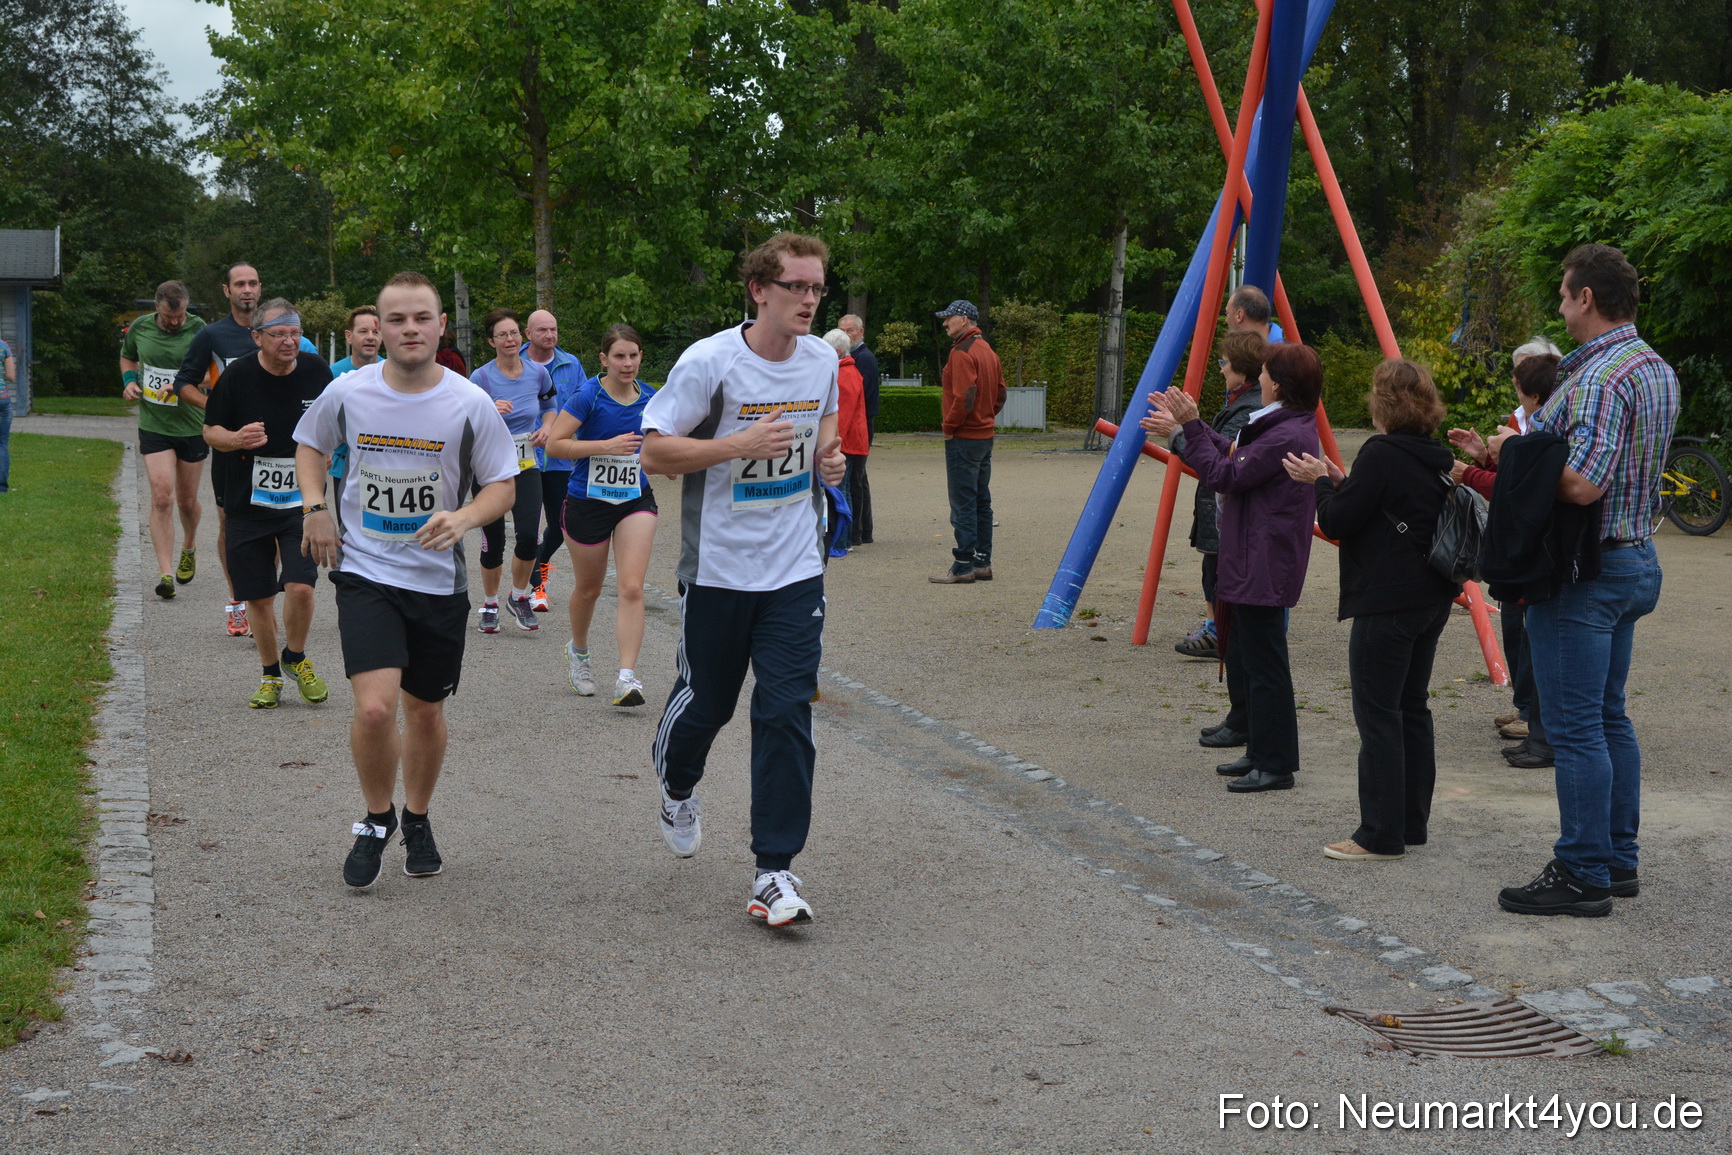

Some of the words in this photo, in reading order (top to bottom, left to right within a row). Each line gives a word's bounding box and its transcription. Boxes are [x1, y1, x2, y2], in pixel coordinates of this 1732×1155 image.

[357, 433, 445, 452] grasenhiller
[384, 448, 417, 456] KOMPETENZ
[591, 456, 610, 464] PARTL
[741, 442, 805, 479] 2121
[258, 469, 299, 490] 294
[360, 469, 384, 482] PARTL
[384, 475, 427, 484] Neumarkt
[594, 464, 637, 485] 2045
[601, 488, 628, 498] Barbara
[744, 480, 802, 498] Maximilian
[269, 493, 292, 503] Volker
[366, 483, 435, 513] 2146
[382, 519, 418, 532] Marco
